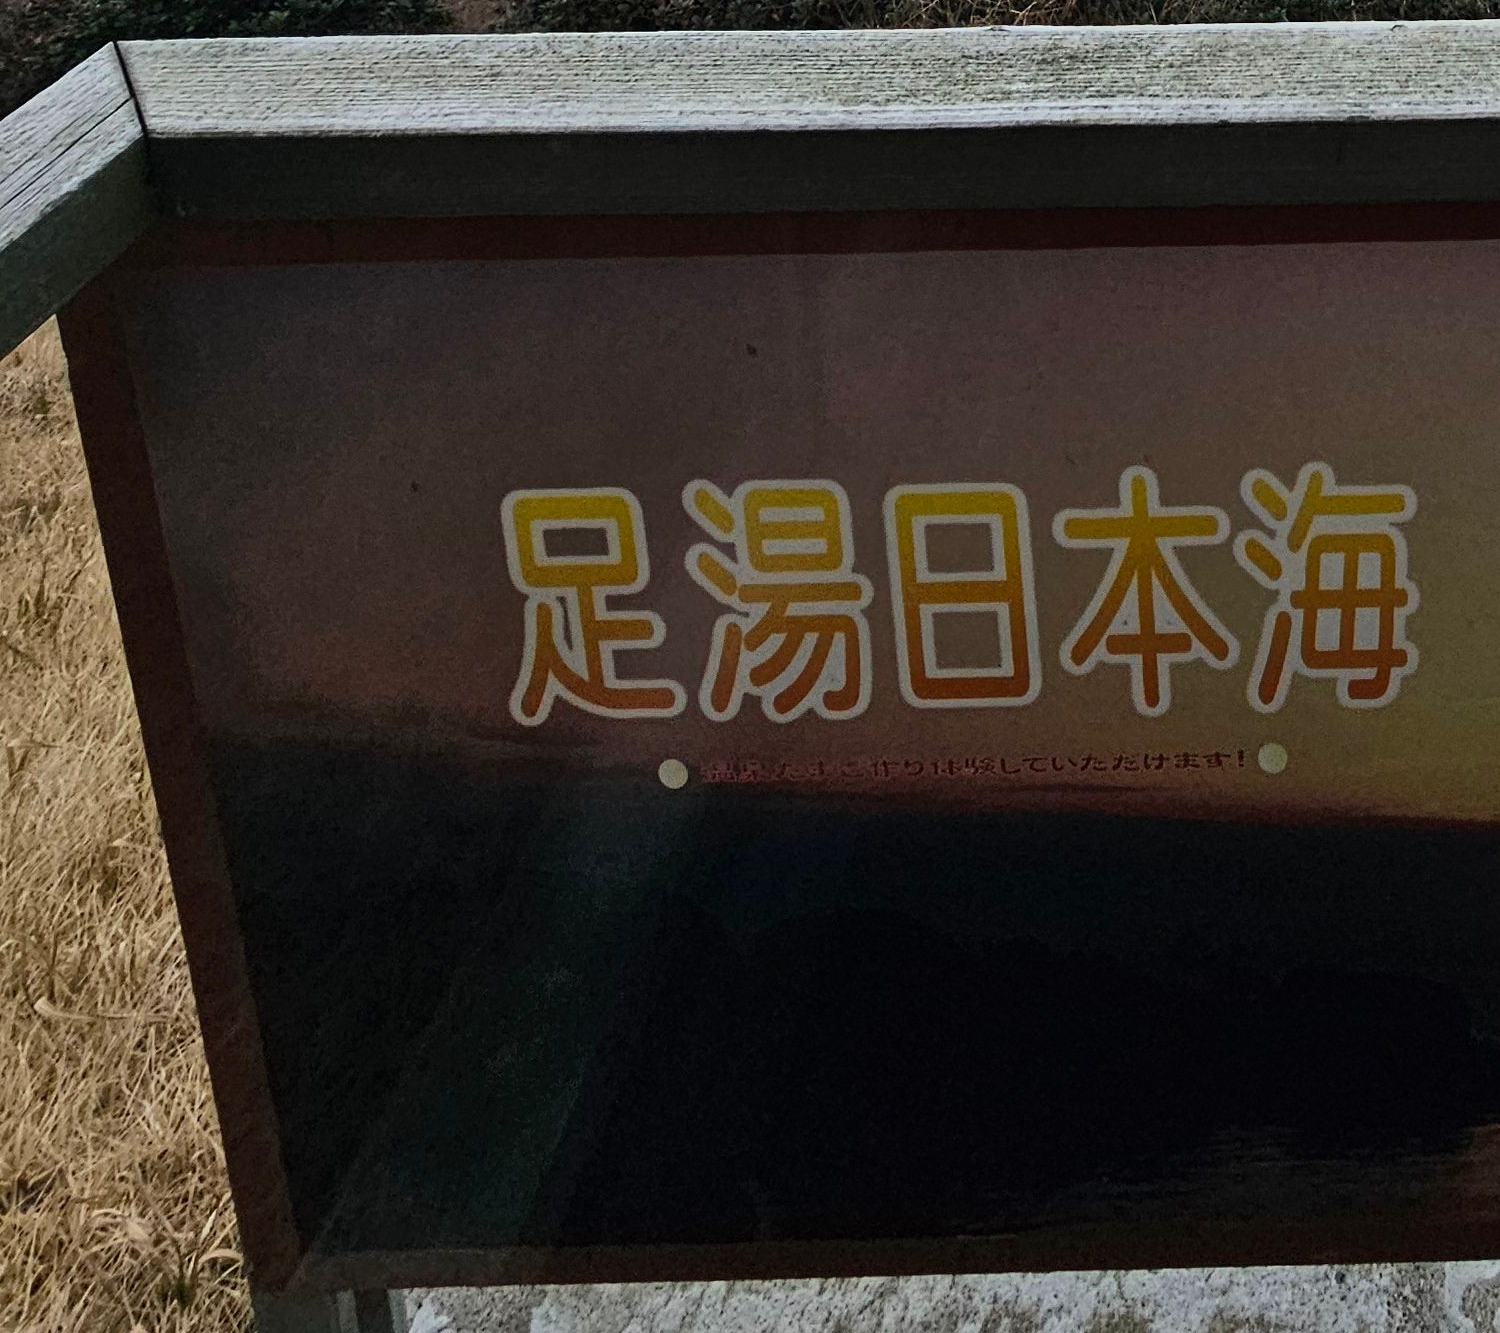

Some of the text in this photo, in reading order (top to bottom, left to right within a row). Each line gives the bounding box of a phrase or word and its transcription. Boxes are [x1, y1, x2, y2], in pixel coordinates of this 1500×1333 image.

[500, 462, 1418, 726] 足湯日本海
